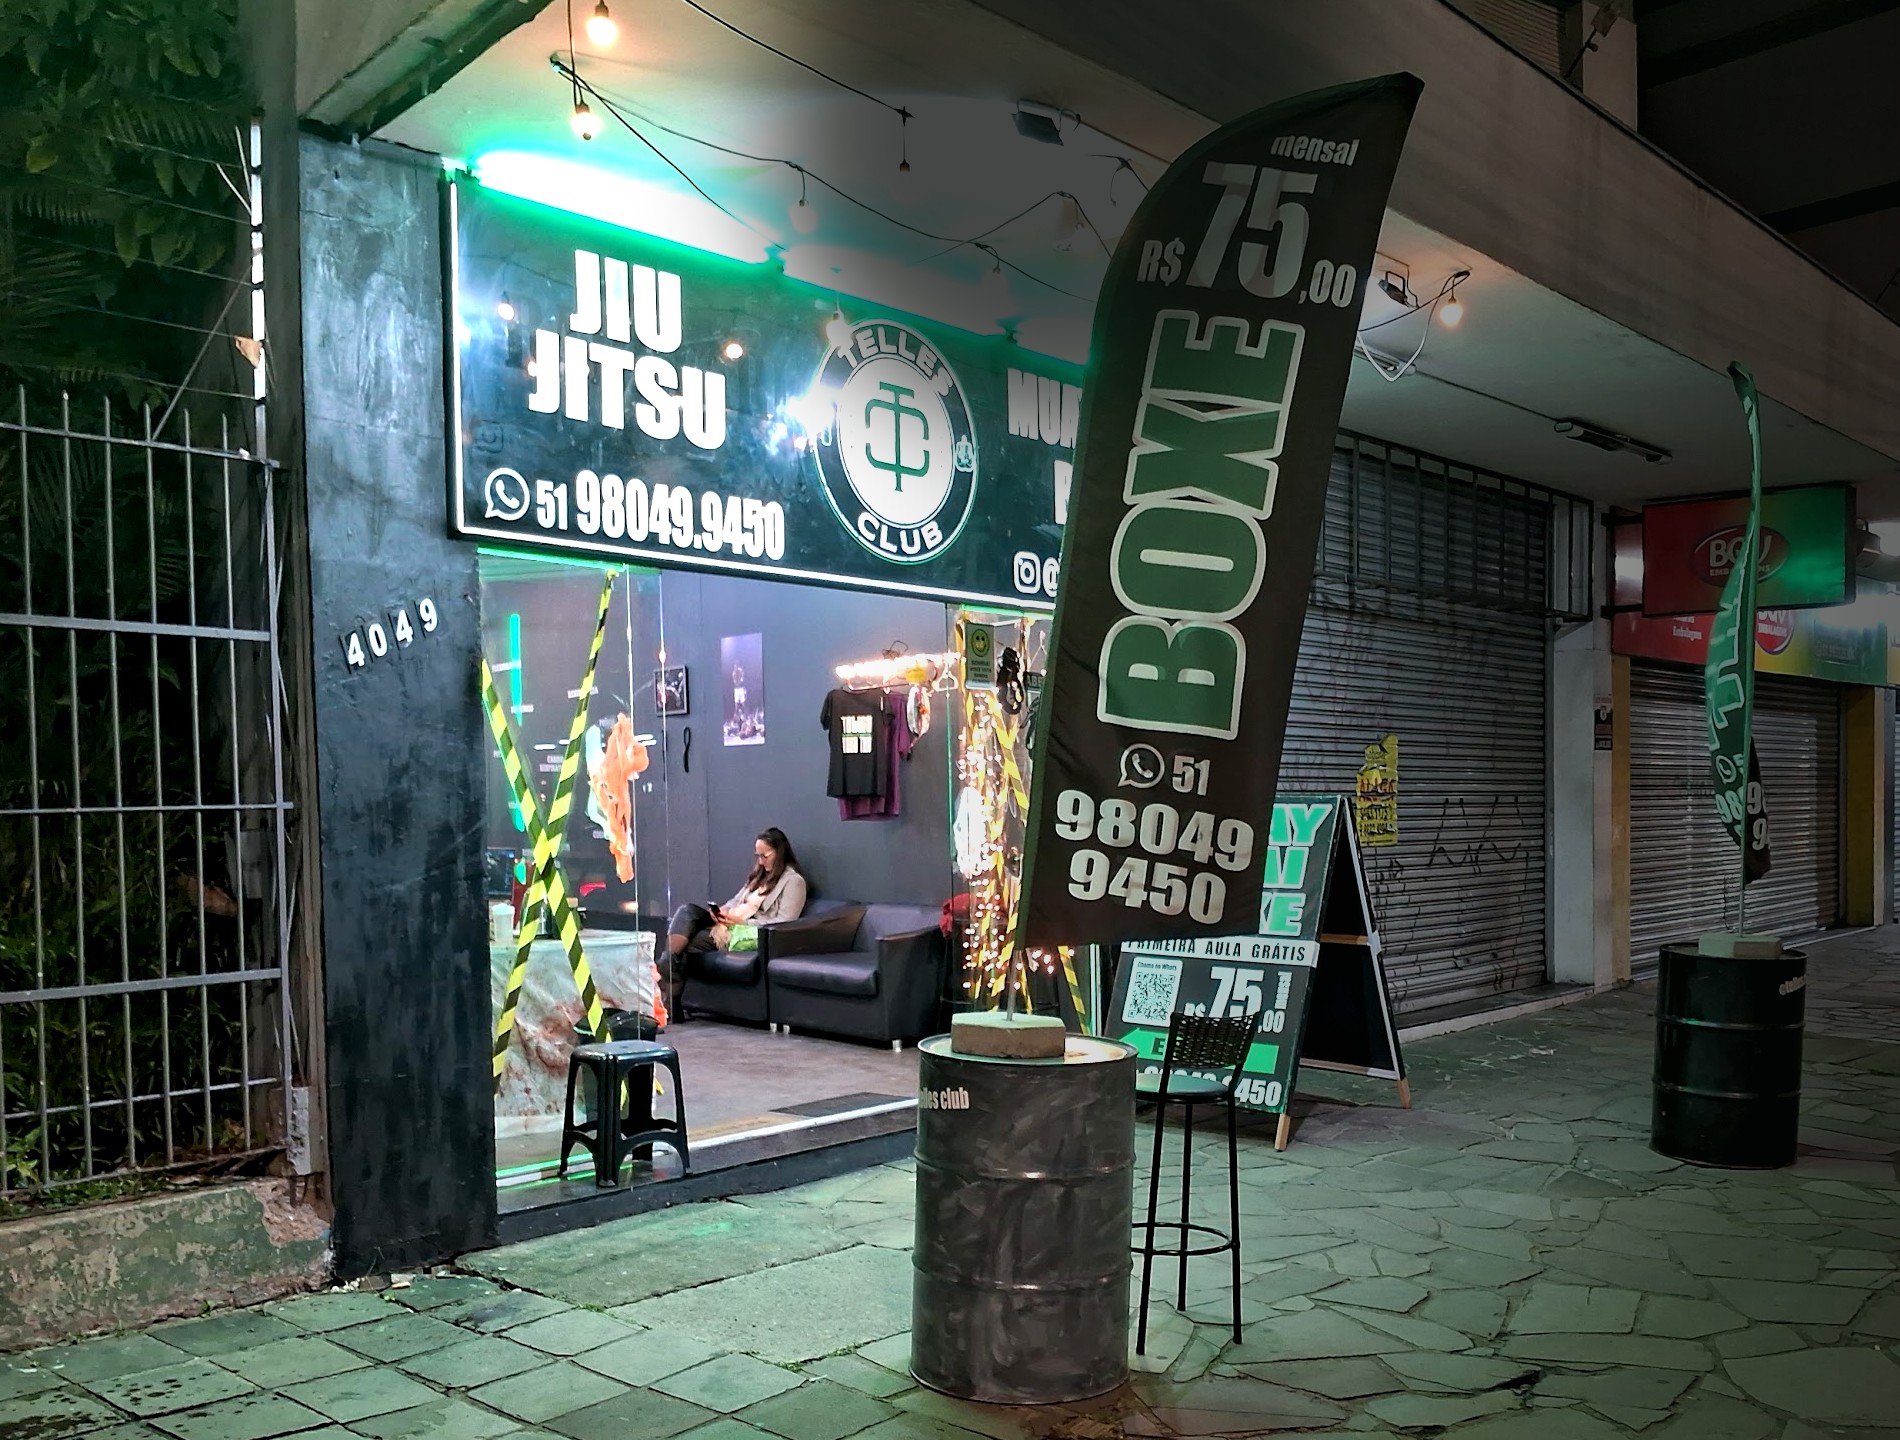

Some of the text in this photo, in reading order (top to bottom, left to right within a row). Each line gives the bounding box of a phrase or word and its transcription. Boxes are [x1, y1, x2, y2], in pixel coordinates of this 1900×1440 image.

[1270, 135, 1360, 166] mensal
[569, 248, 682, 354] JIU
[528, 328, 727, 450] JITSU
[838, 327, 953, 396] TELLES
[535, 470, 785, 560] 51 98049.9450
[857, 511, 943, 555] CLUB
[1097, 309, 1305, 741] BOXE
[348, 598, 438, 667] 4049
[1172, 755, 1211, 796] 51
[1055, 789, 1254, 872] 98049
[1068, 848, 1226, 925] 9450
[1205, 941, 1241, 957] AULA
[1252, 943, 1306, 962] GRÁTIS
[940, 1086, 970, 1110] club
